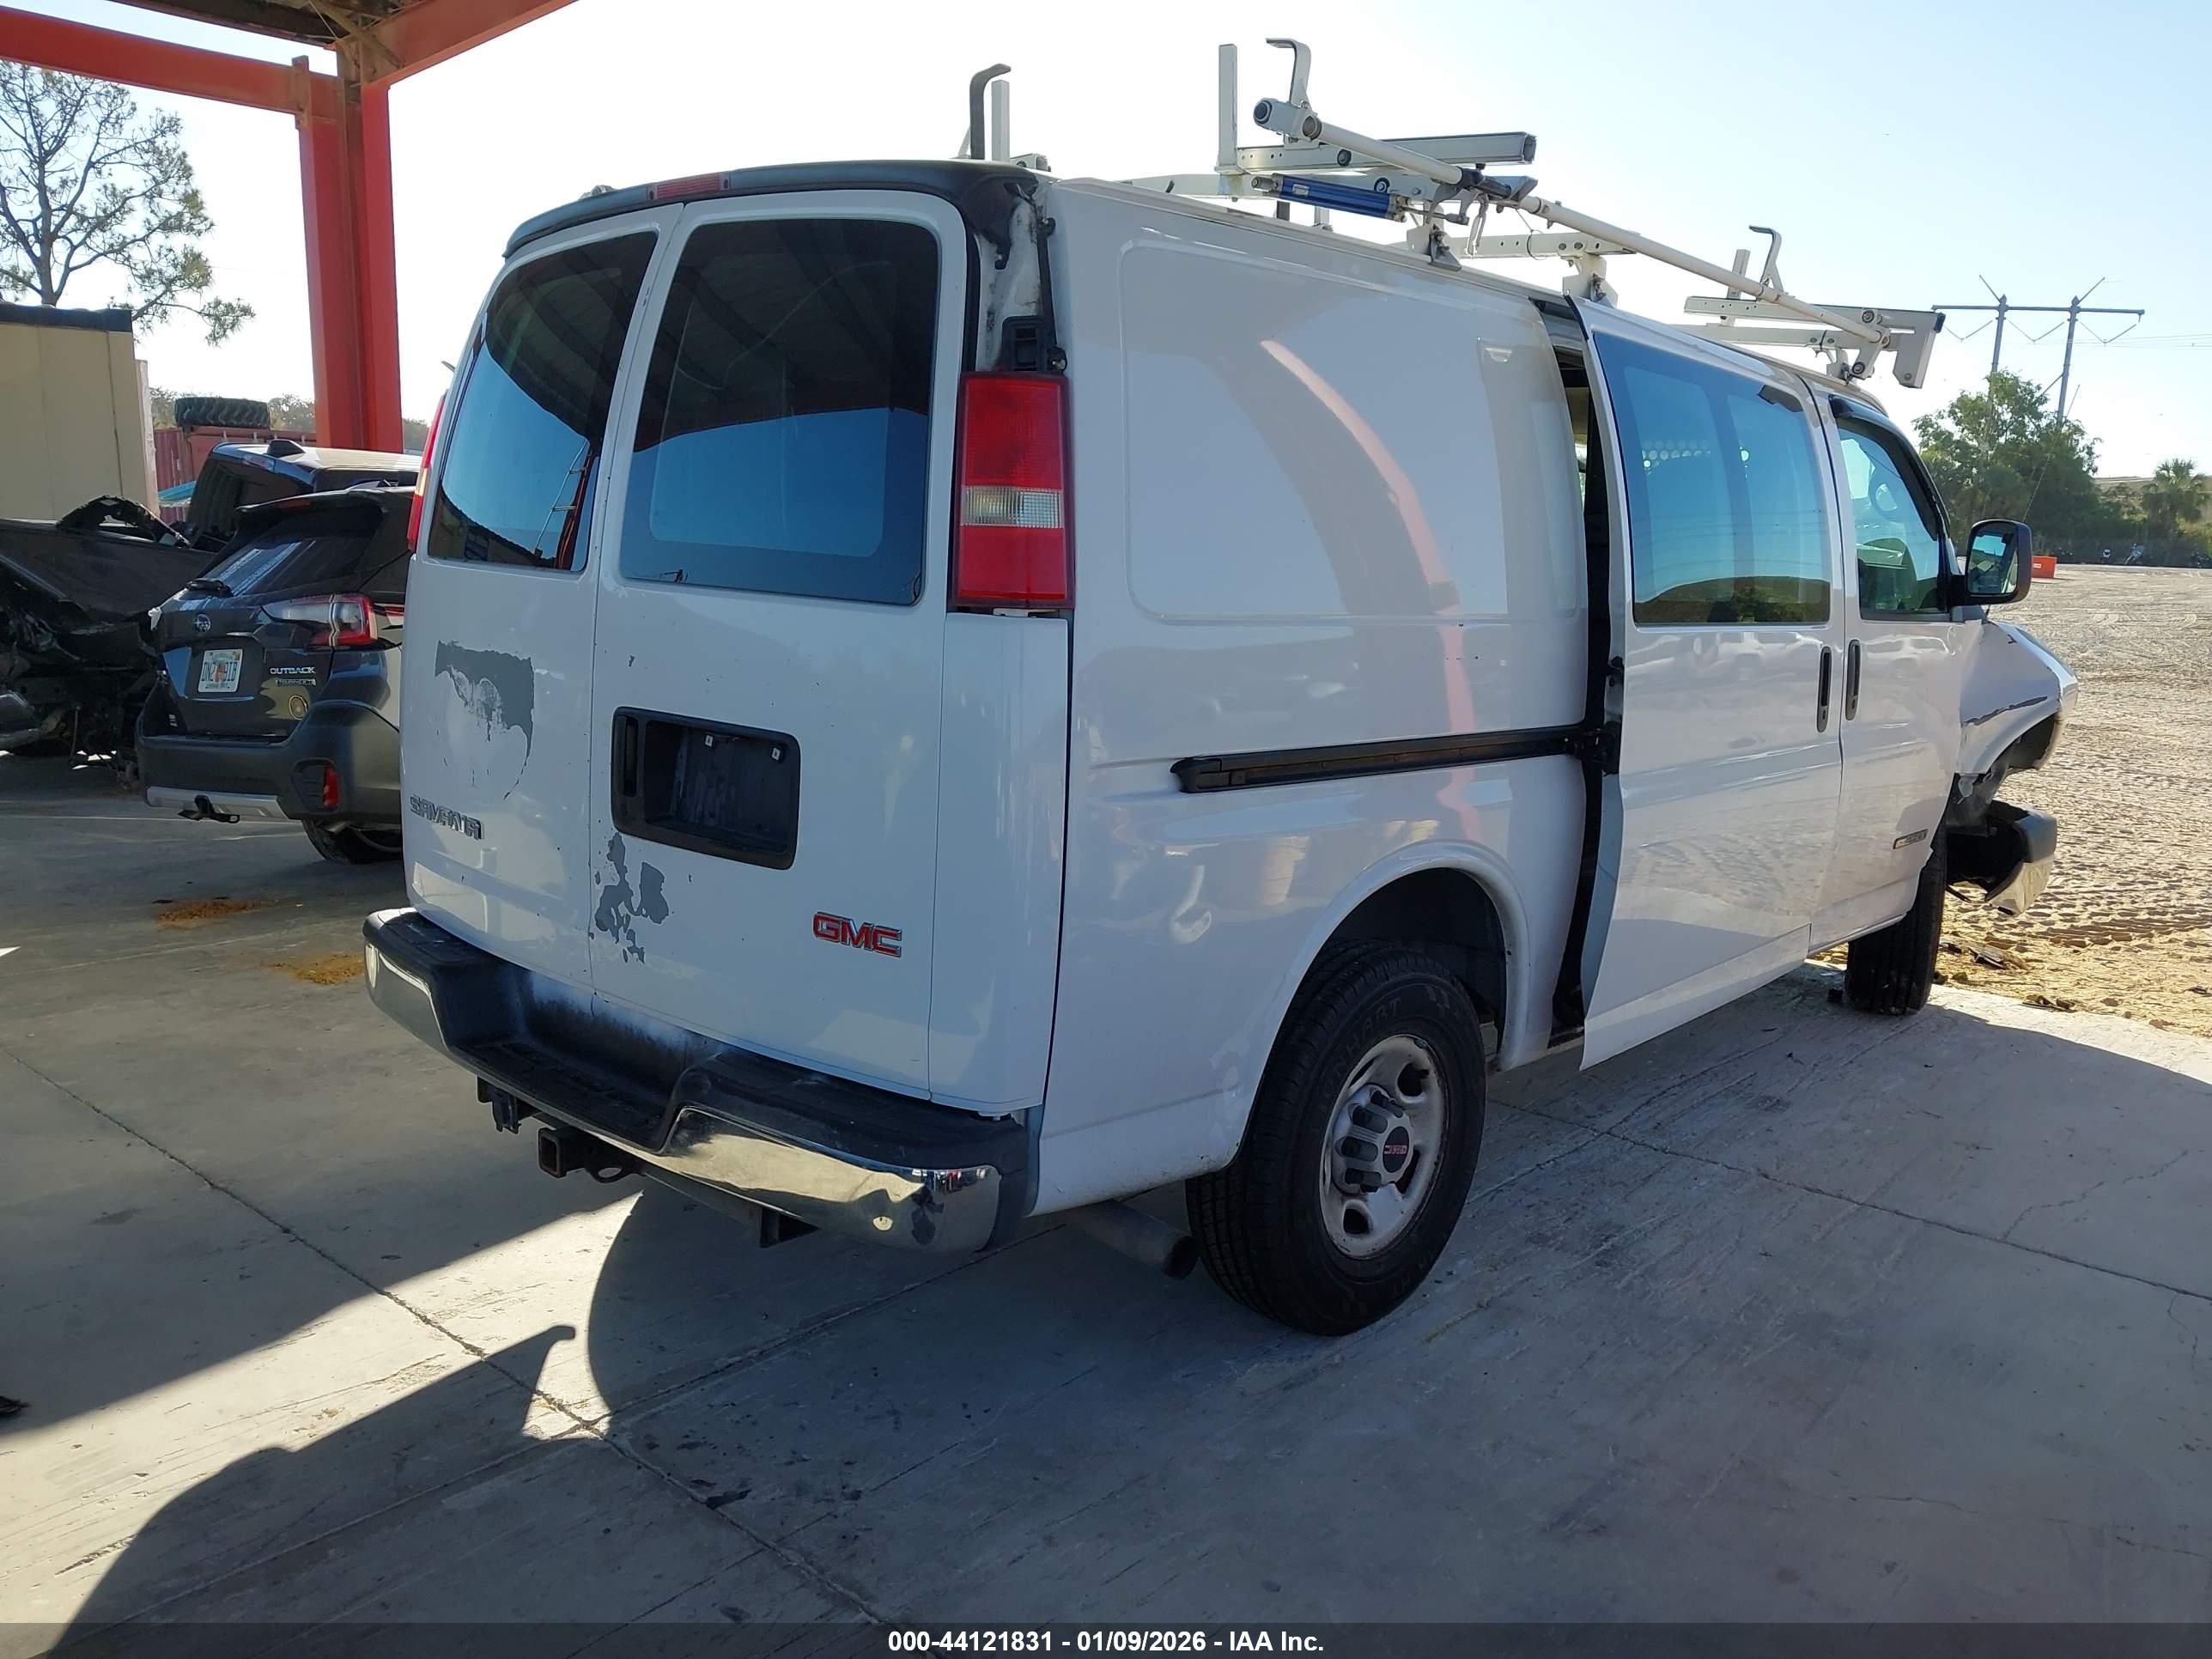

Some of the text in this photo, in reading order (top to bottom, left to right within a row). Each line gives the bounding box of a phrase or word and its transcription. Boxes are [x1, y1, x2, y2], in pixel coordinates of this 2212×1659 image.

[270, 666, 316, 675] OUTBACK
[410, 795, 483, 841] SAVANA
[813, 911, 902, 958] GMC
[1383, 1145, 1408, 1155] GMC
